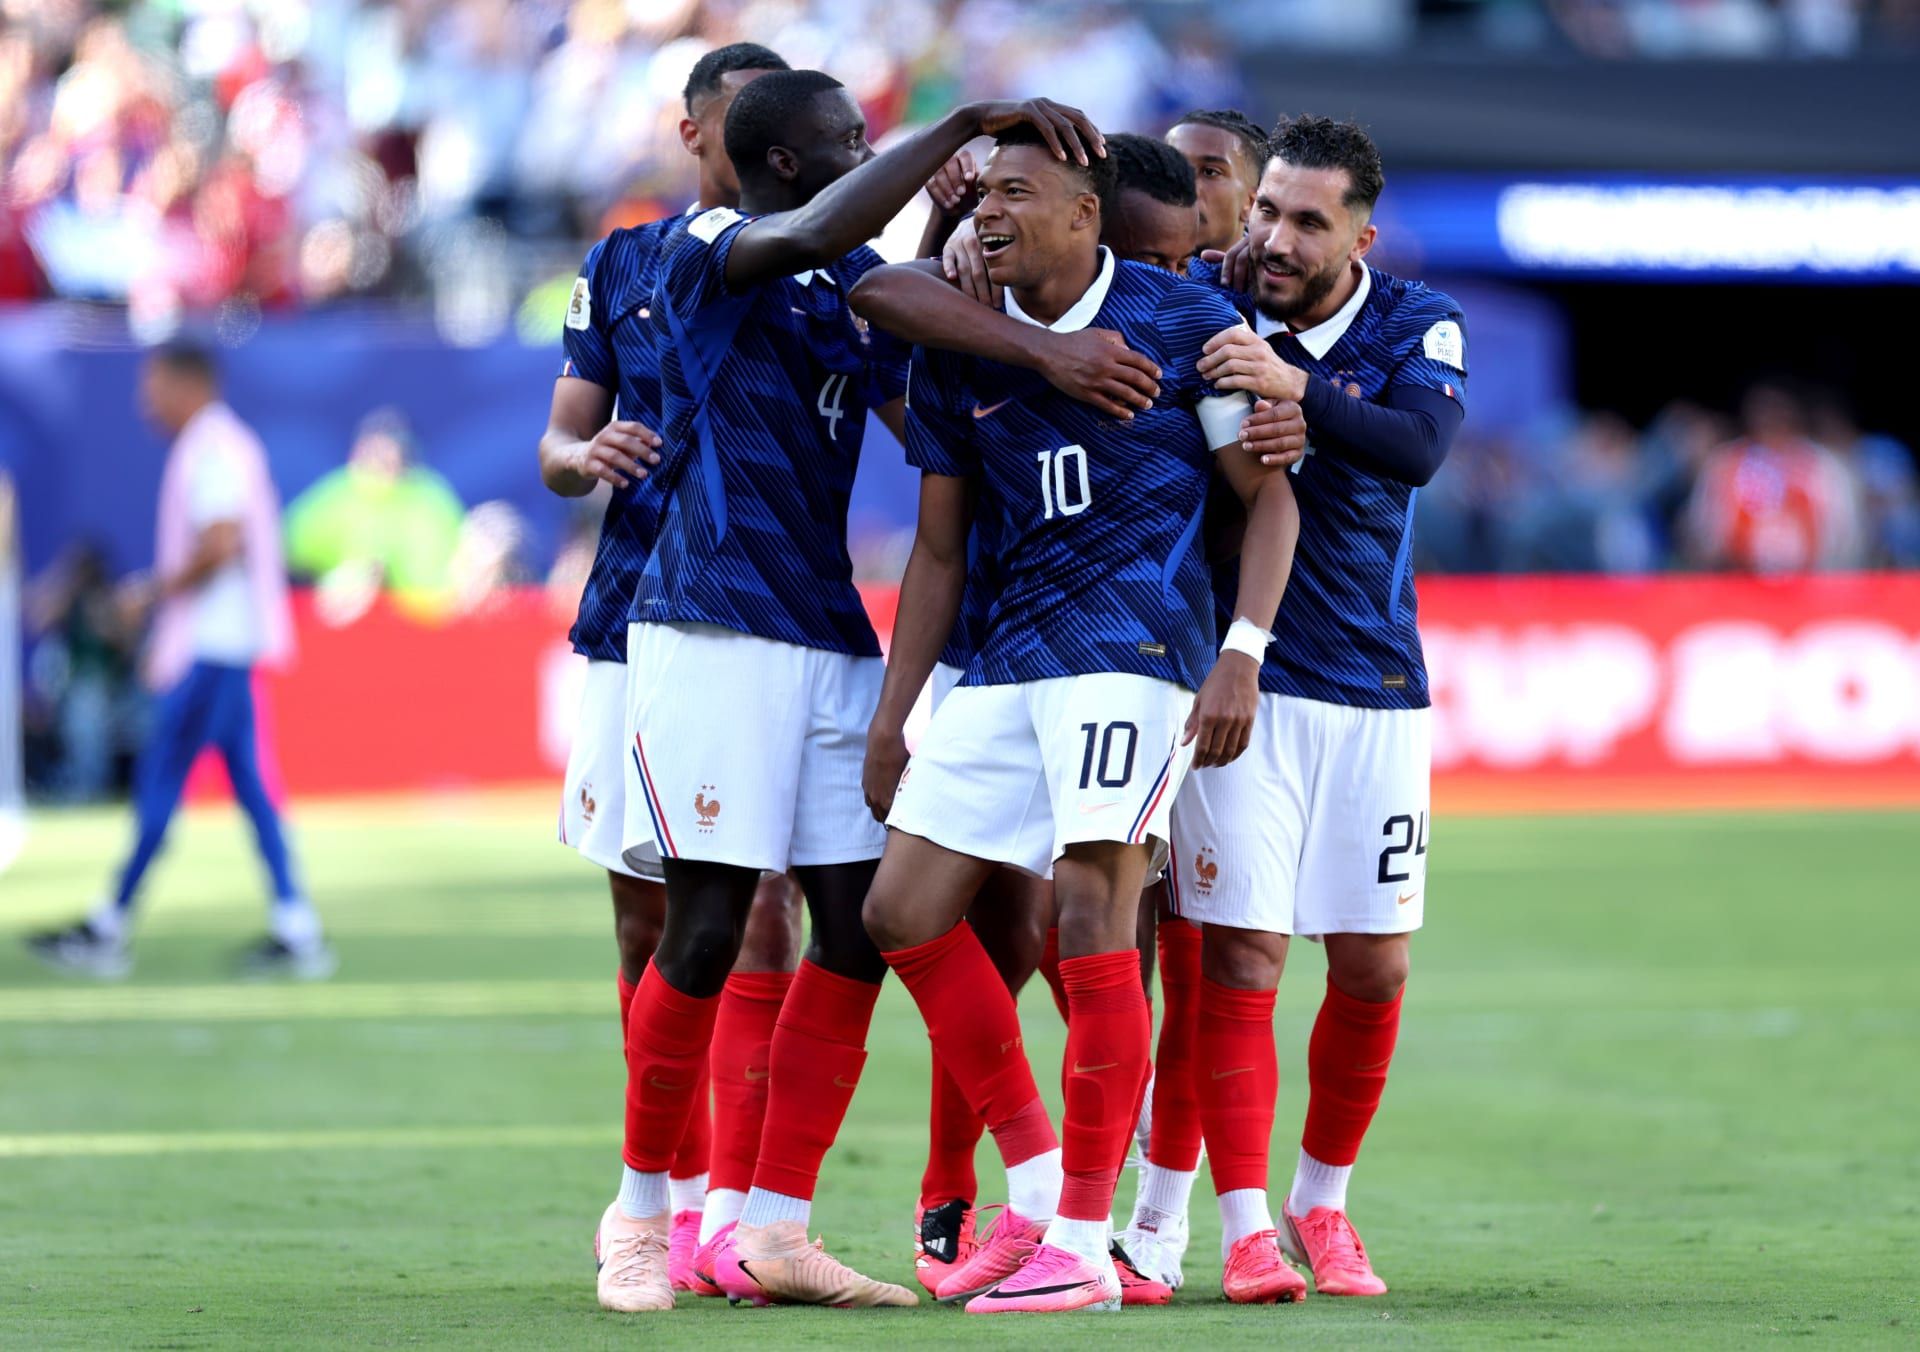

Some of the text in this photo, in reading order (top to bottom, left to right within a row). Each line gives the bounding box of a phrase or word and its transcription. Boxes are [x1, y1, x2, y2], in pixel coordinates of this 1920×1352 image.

[817, 374, 848, 441] 4
[1037, 444, 1092, 519] 10
[1079, 720, 1138, 789] 10
[1377, 811, 1428, 884] 24
